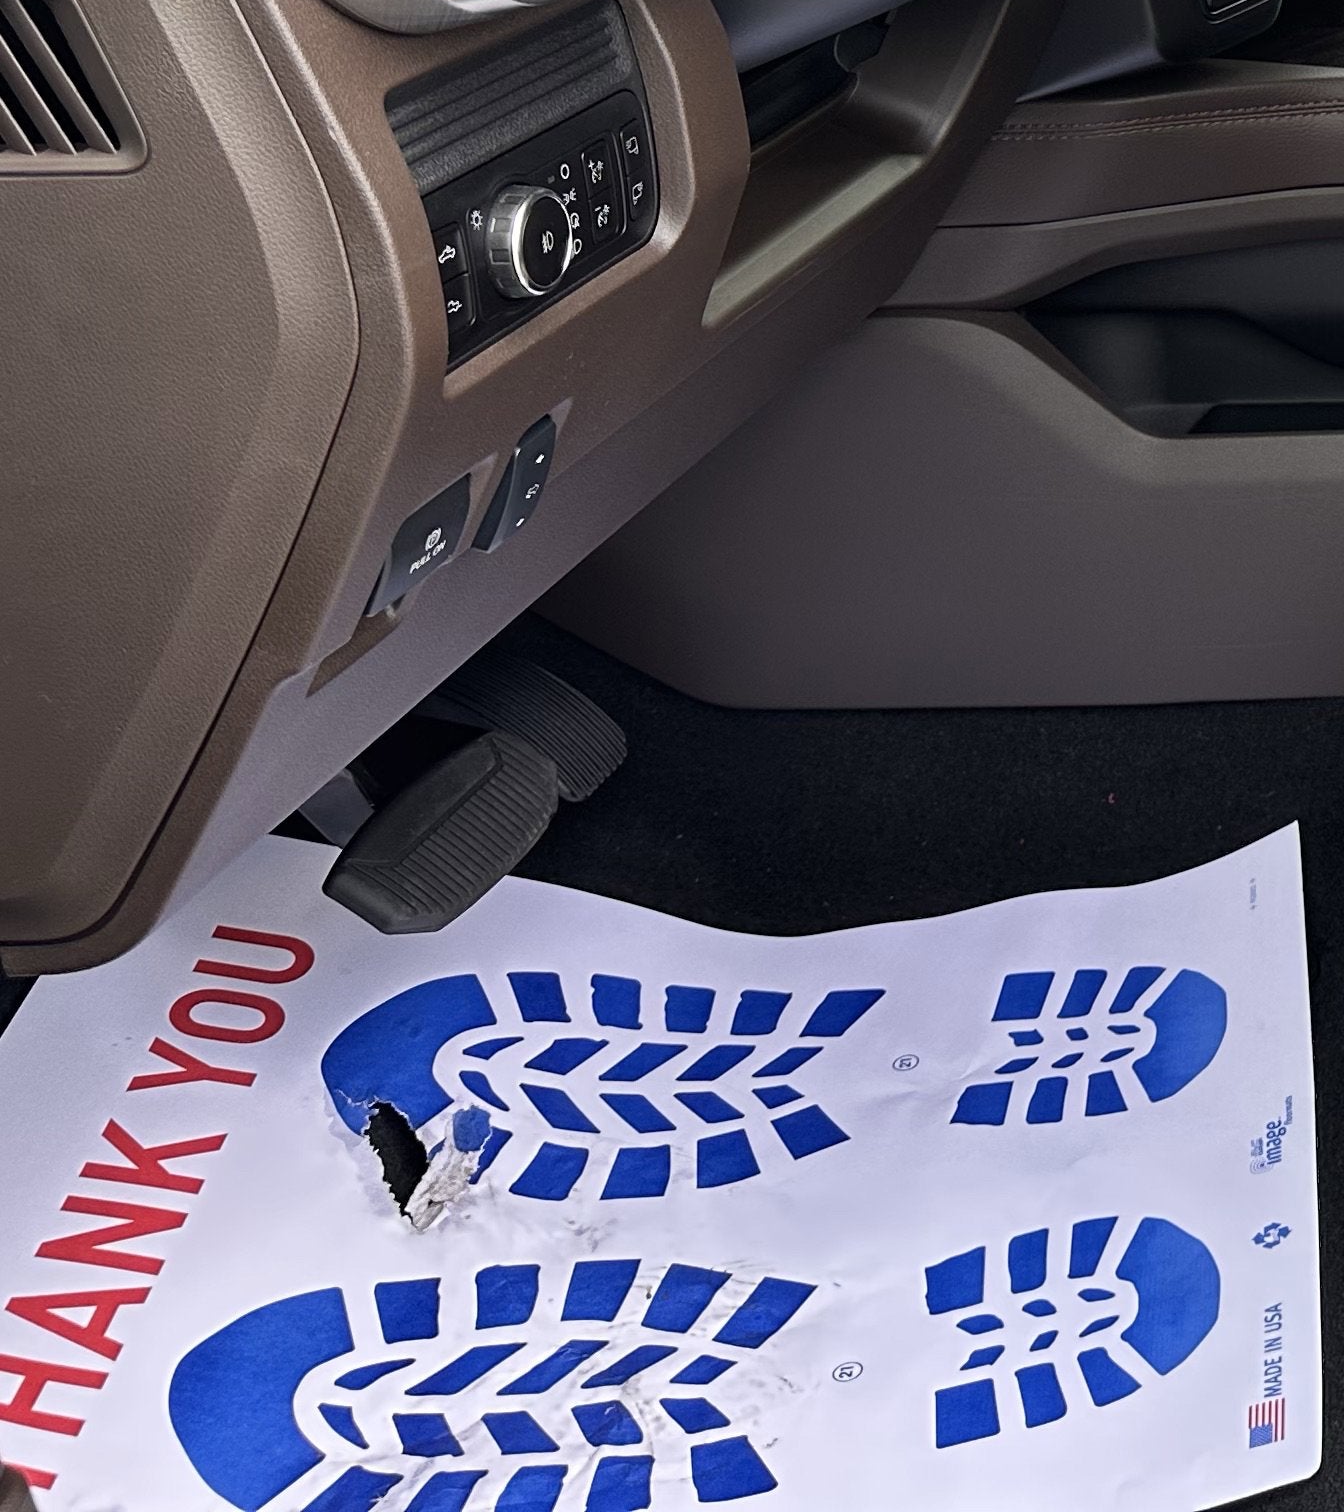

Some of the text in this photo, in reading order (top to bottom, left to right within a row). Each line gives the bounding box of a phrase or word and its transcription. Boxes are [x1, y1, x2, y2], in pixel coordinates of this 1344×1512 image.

[409, 539, 447, 574] PULL ON
[1265, 1119, 1287, 1165] image
[0, 924, 315, 1491] HANK YOU
[1263, 1302, 1283, 1399] MADE IN USA
